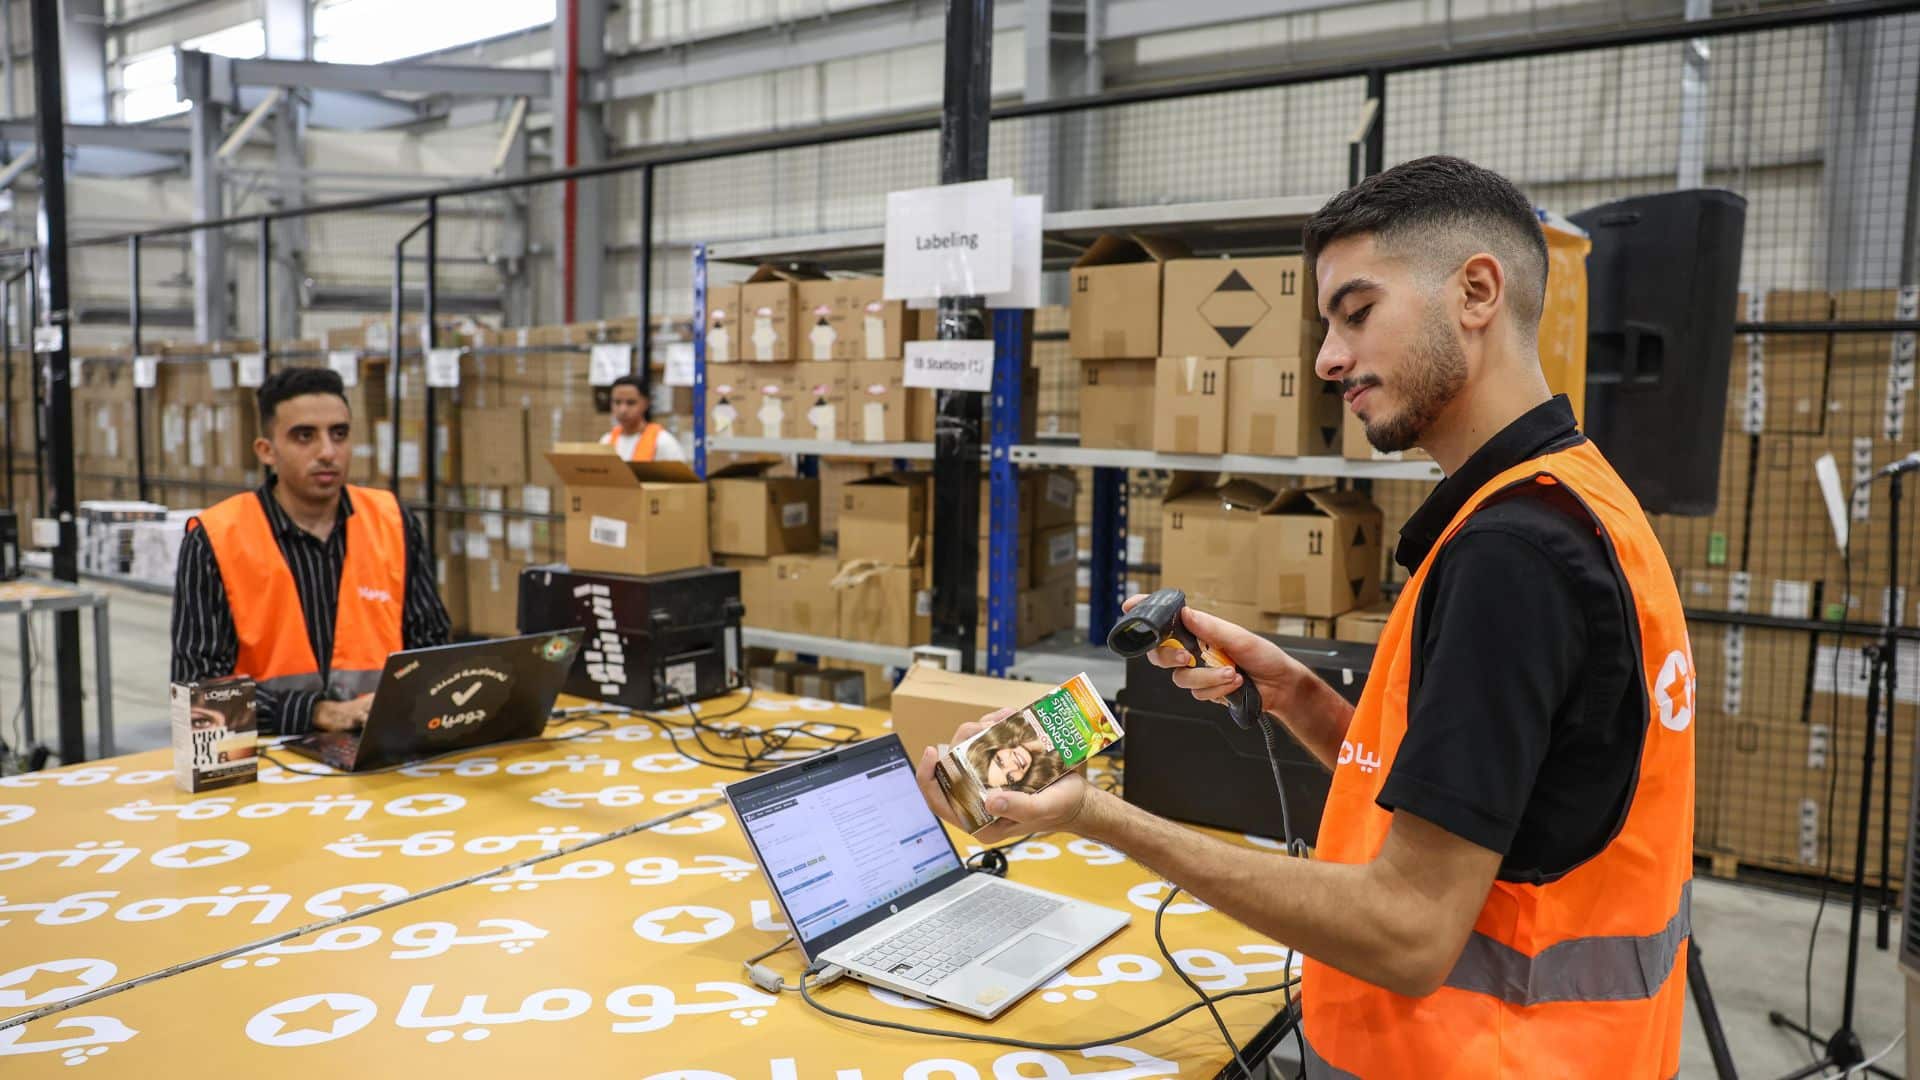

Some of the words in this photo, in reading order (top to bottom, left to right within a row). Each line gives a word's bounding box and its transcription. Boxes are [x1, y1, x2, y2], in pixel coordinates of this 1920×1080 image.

[916, 231, 979, 250] Labeling
[927, 356, 966, 372] Station
[193, 730, 225, 744] PRO
[1037, 708, 1073, 759] GARNIER
[1053, 712, 1075, 746] Color
